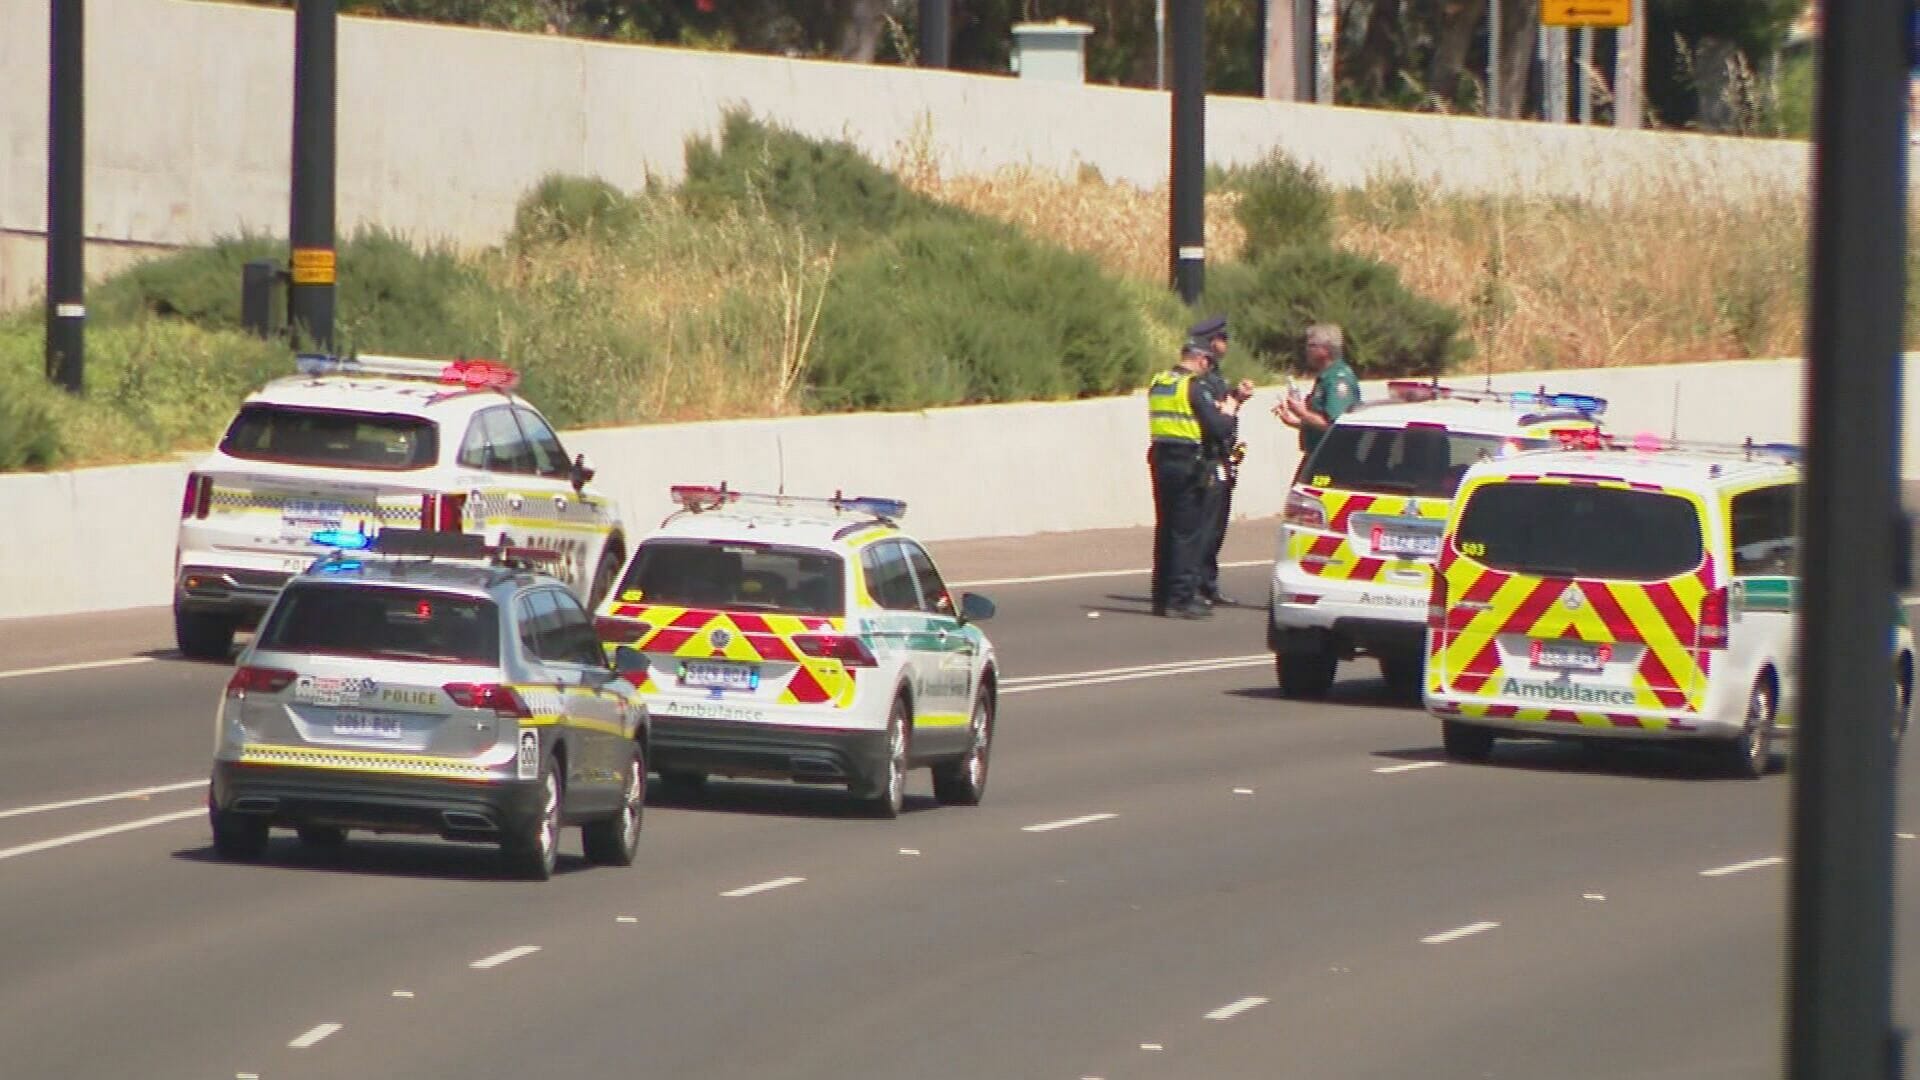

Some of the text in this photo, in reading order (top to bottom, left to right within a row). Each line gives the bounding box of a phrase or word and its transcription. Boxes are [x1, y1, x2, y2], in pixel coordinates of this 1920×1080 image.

[1360, 591, 1427, 608] Ambulan
[383, 689, 438, 705] POLICE
[1502, 677, 1635, 704] Ambulance
[667, 701, 764, 720] Ambulance
